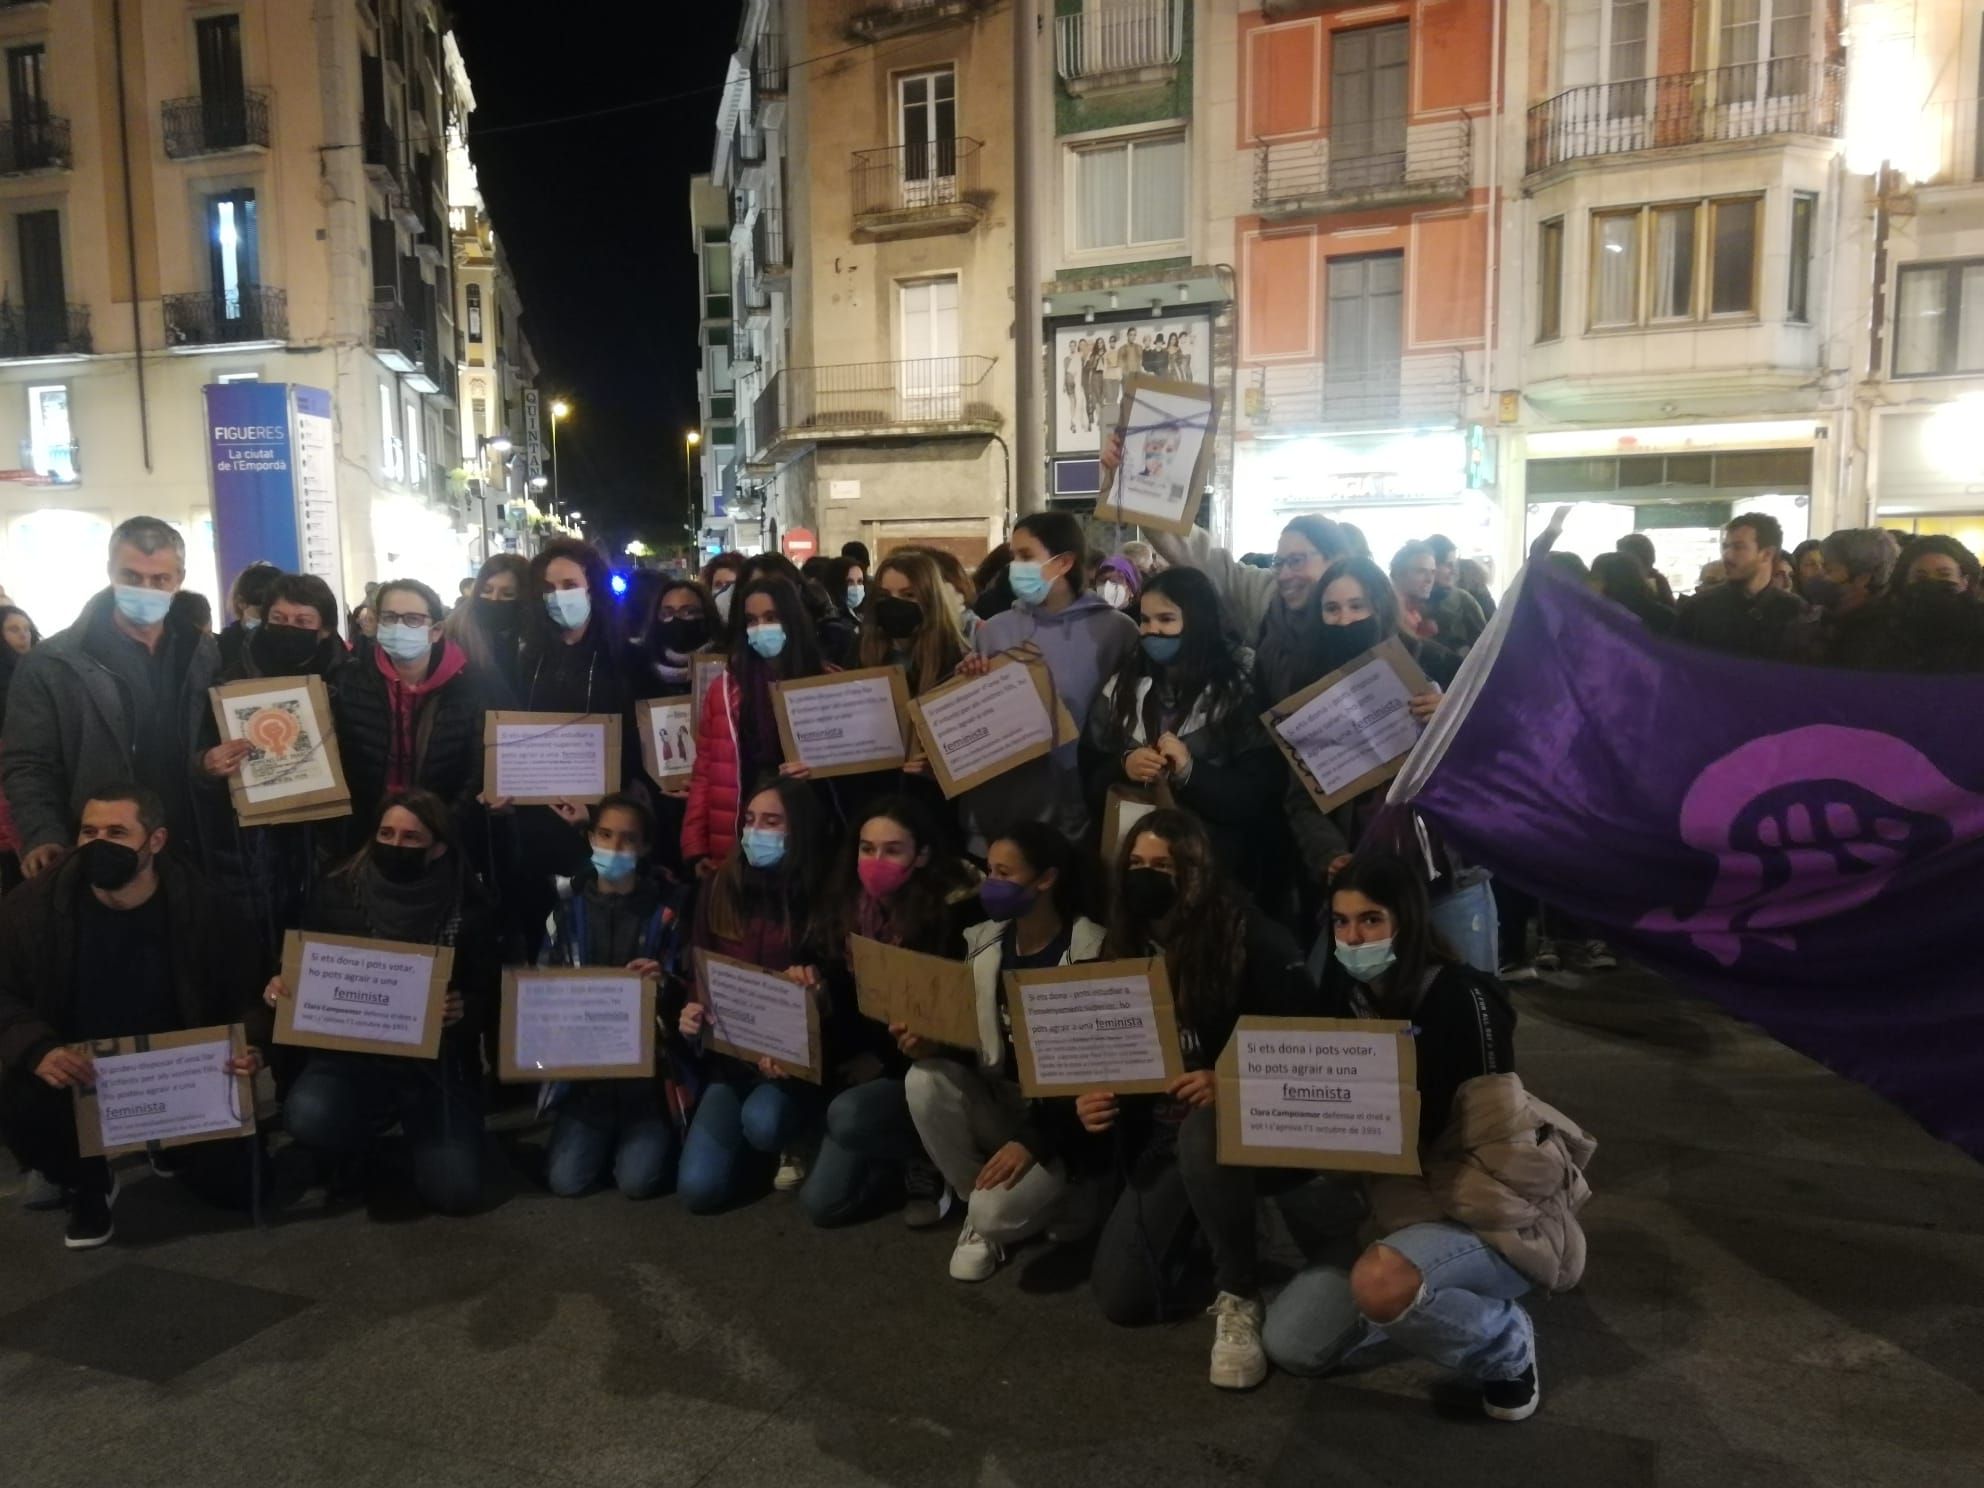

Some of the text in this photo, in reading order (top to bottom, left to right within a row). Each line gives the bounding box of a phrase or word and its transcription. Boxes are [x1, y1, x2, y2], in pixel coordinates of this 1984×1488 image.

[215, 426, 284, 440] FIGUERES
[527, 392, 540, 490] QUINTAN
[229, 449, 274, 459] La ciutat
[218, 460, 287, 474] de l'Empordà
[1351, 696, 1405, 733] feminista
[942, 725, 991, 753] feminista
[312, 952, 319, 961] Si
[321, 954, 334, 963] ets
[337, 956, 360, 966] dona
[366, 959, 387, 971] pots
[389, 962, 415, 973] votar,
[309, 968, 320, 977] ho
[322, 970, 342, 981] pots
[344, 972, 370, 984] agrair
[380, 978, 398, 986] una
[333, 986, 390, 1004] feminista
[1119, 1001, 1130, 1009] ho
[1096, 1016, 1144, 1030] feminista
[1247, 1043, 1376, 1057] Si ets dona i pots votar,
[1248, 1063, 1357, 1077] ho pots agrair a una
[1283, 1084, 1352, 1101] feminista
[106, 1101, 166, 1119] feminista
[1250, 1108, 1270, 1117] Clara
